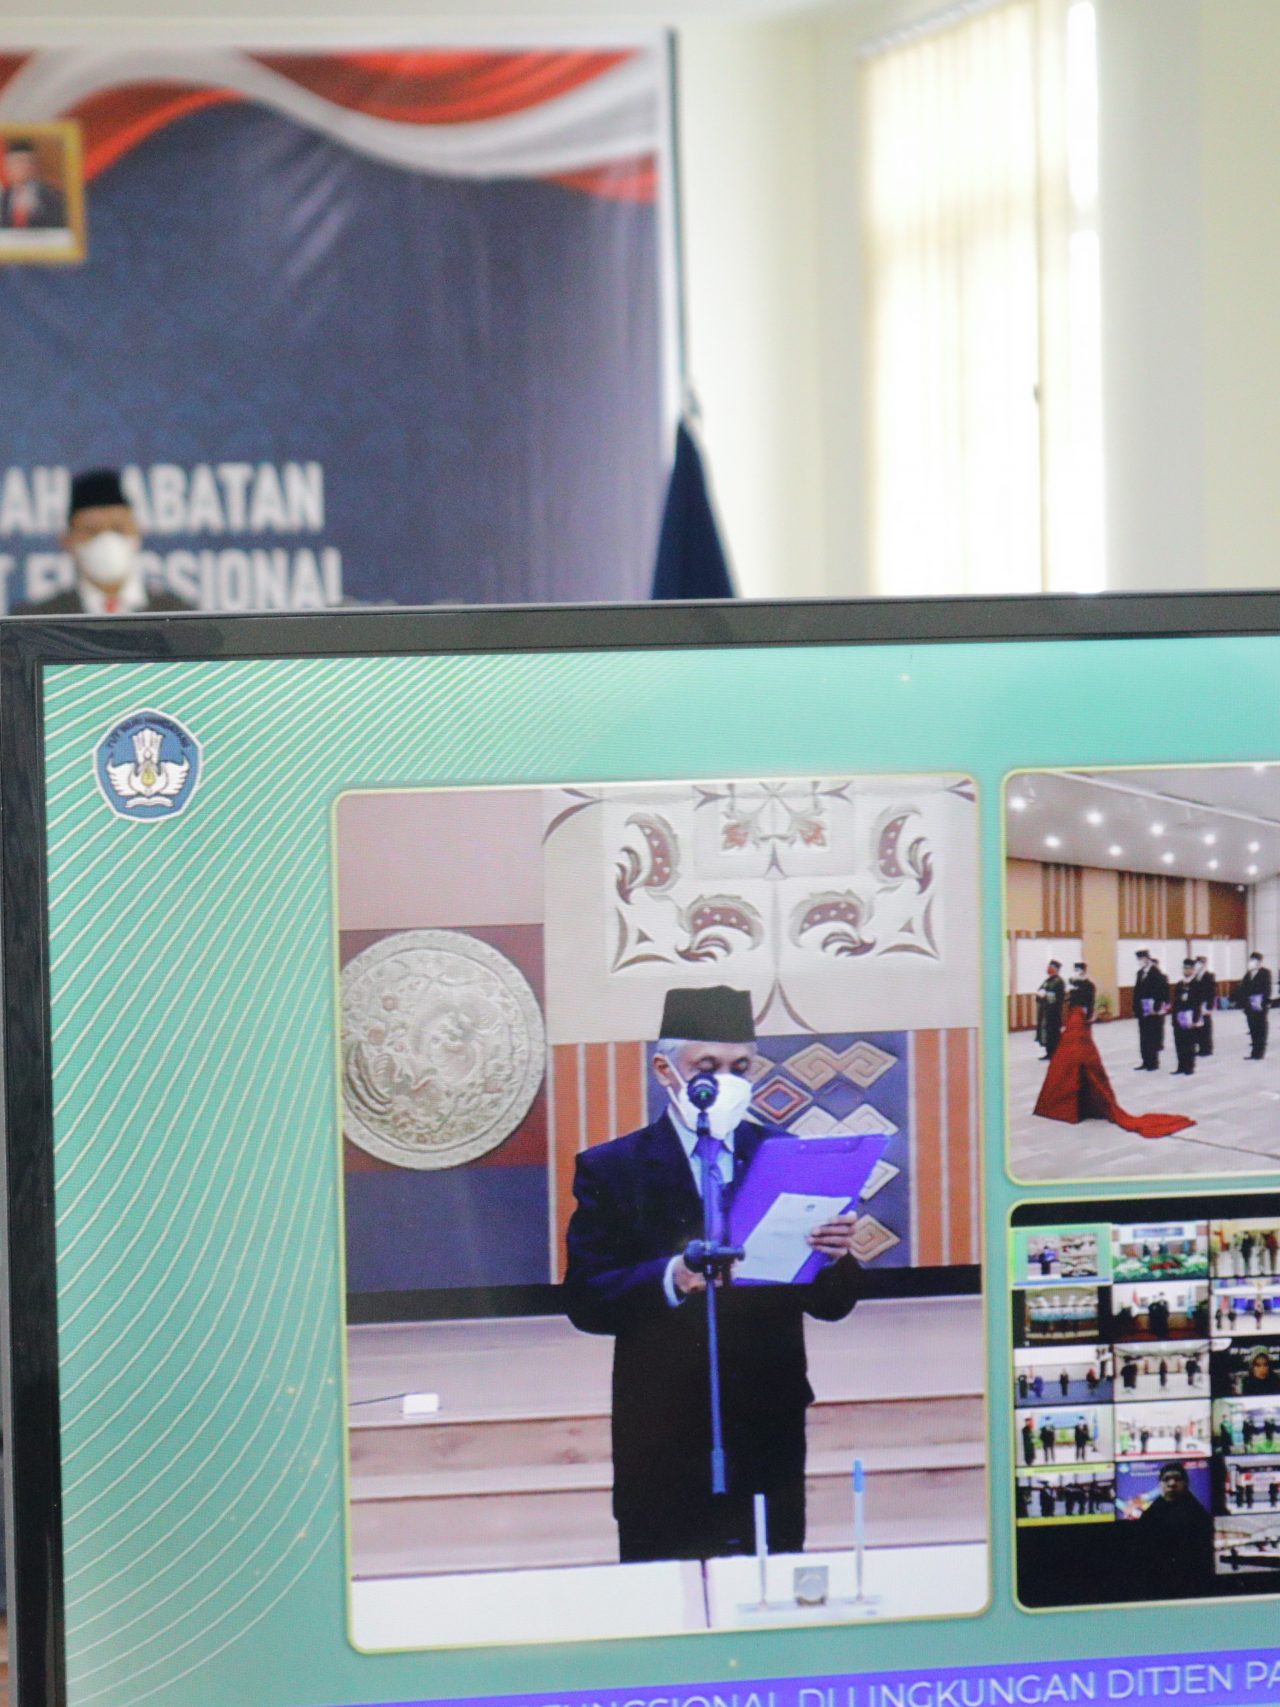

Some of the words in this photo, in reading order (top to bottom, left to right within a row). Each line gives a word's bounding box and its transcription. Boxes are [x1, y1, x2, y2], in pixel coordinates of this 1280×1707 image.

[122, 460, 326, 533] ABATAN
[849, 1670, 1097, 1707] LINGKUNGAN
[1107, 1662, 1233, 1699] DITJEN
